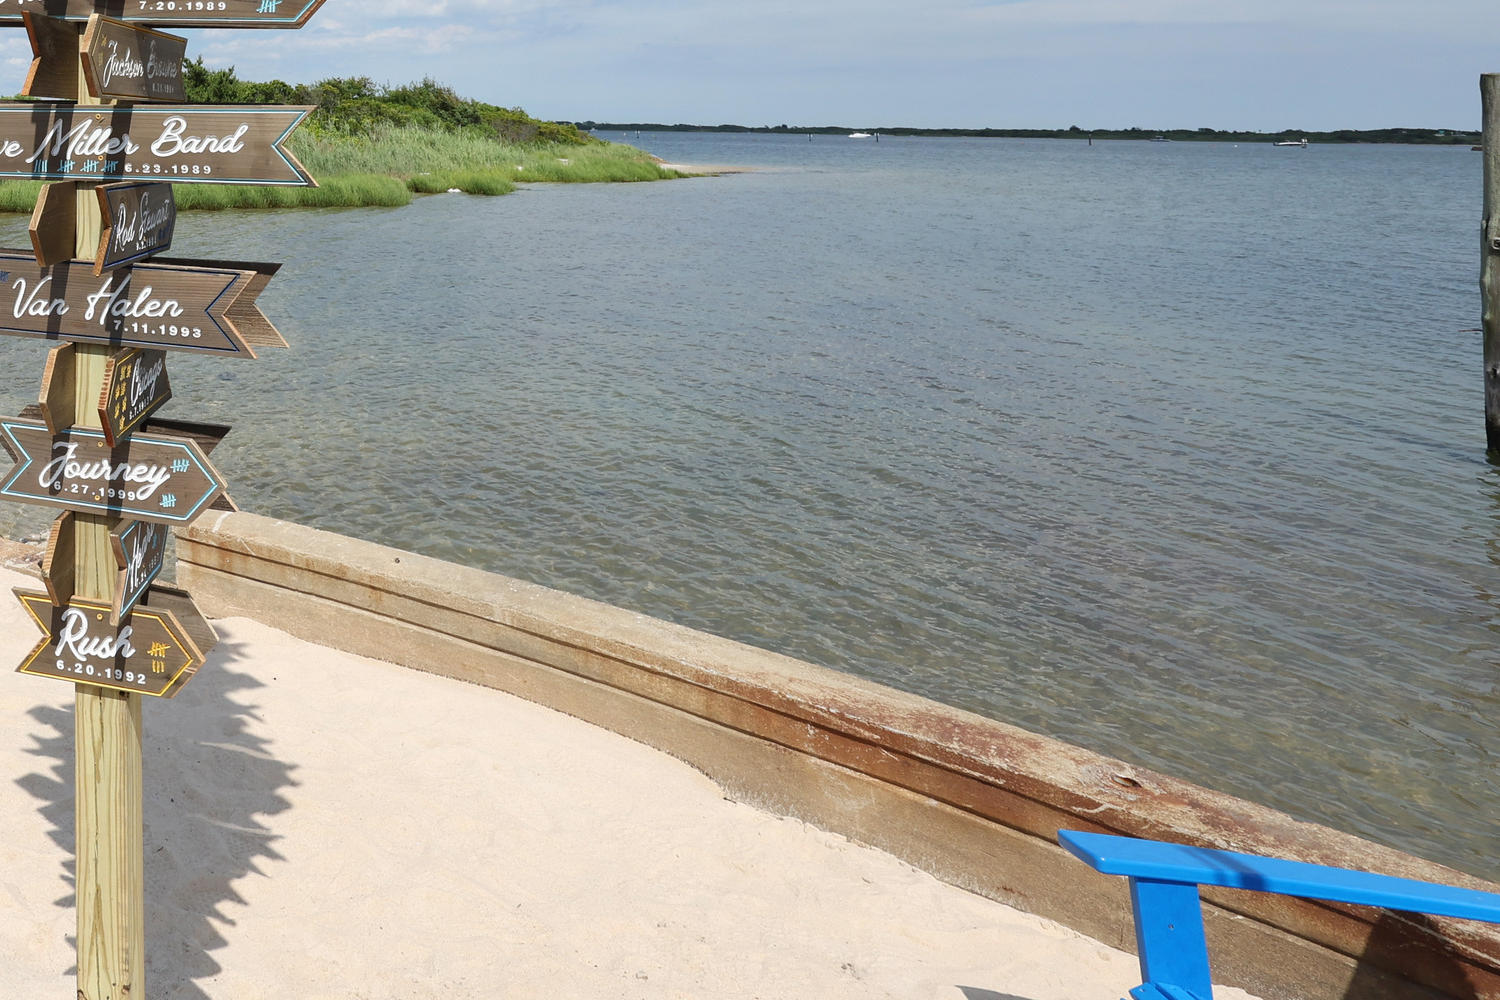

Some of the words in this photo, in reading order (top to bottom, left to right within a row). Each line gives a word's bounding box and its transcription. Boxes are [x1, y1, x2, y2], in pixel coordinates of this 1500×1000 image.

[139, 1, 227, 12] 7.20.1989
[103, 40, 144, 88] Jackson
[25, 115, 139, 163] Miller
[150, 115, 249, 157] Band
[124, 163, 213, 175] 6.23.1989
[114, 203, 137, 253] Rod
[138, 191, 171, 240] Stewart
[12, 275, 70, 318] Van
[84, 273, 184, 326] Halen
[113, 319, 202, 338] 7.11.1993
[130, 357, 163, 407] Chicago
[38, 441, 171, 501] Journey
[53, 480, 136, 501] 6.27.1999
[54, 607, 136, 662] Rush
[56, 659, 147, 685] 6.20.1992
